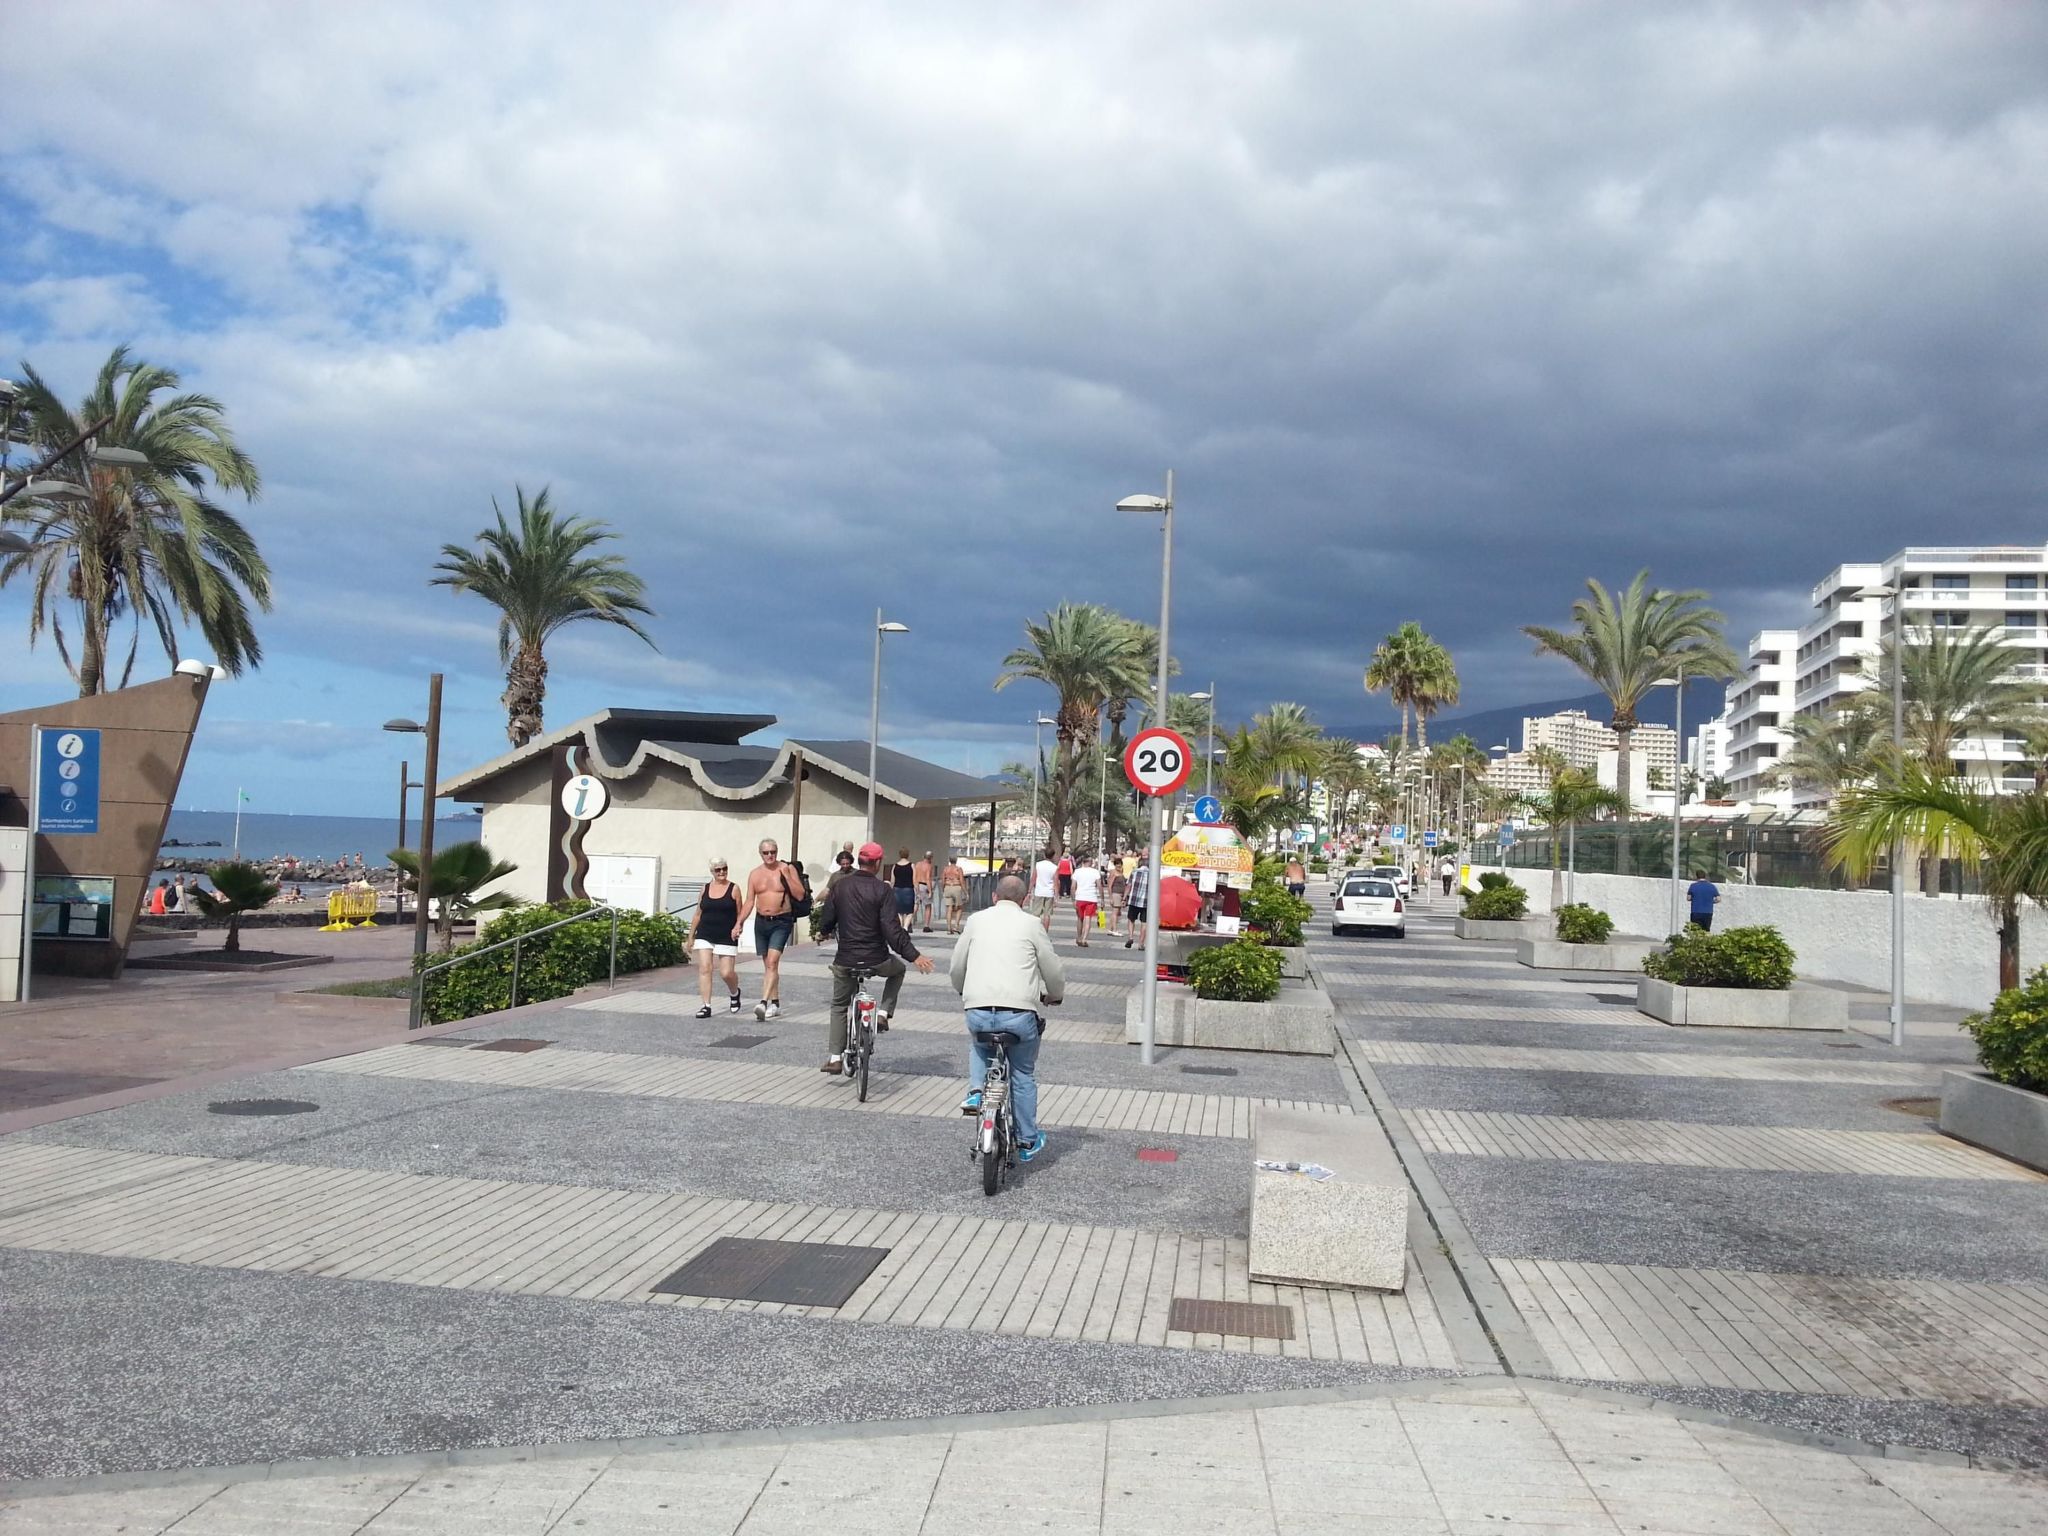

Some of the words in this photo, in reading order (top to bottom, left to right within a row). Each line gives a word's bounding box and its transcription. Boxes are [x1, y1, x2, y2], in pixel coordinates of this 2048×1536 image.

[1138, 749, 1181, 773] 20
[1393, 827, 1402, 838] P
[1210, 845, 1239, 855] SHAKE
[1163, 854, 1196, 865] Crepes
[1198, 856, 1239, 867] BATIDOS
